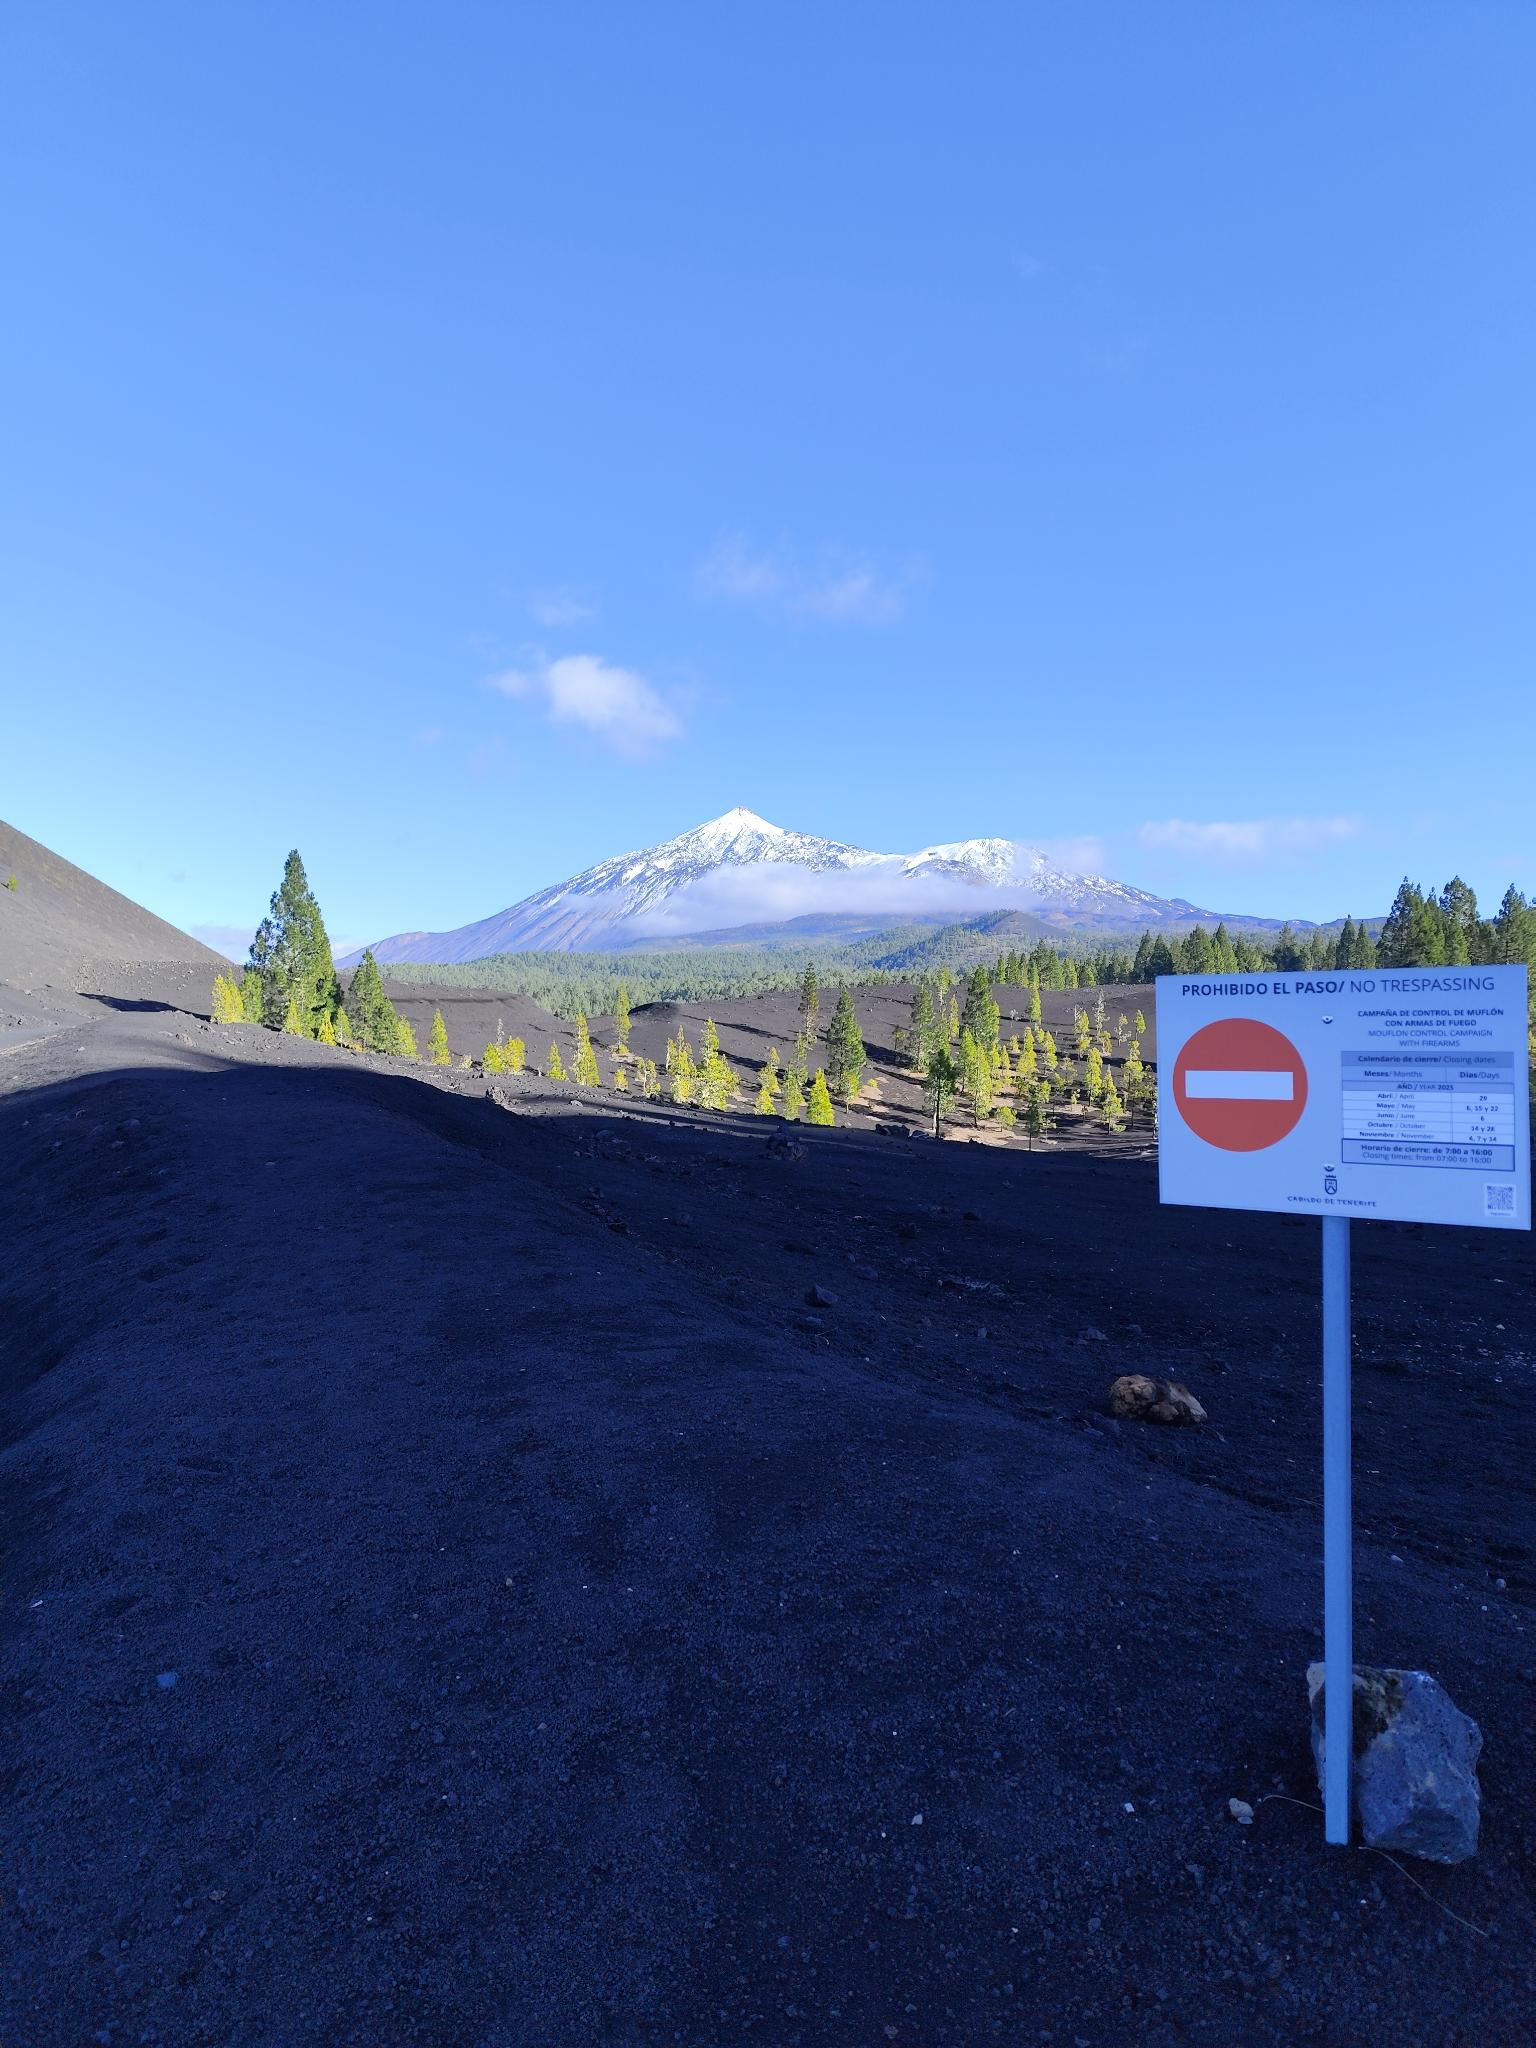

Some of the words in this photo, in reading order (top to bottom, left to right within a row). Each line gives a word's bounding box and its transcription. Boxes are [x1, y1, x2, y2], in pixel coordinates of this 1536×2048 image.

[1182, 982, 1268, 996] PROHIBIDO
[1273, 982, 1291, 995] EL
[1295, 980, 1345, 995] PASO/
[1350, 979, 1376, 994] NO
[1380, 976, 1495, 993] TRESPASSING
[1357, 1009, 1398, 1017] CAMPAÑA
[1412, 1009, 1452, 1017] CONTROL
[1467, 1008, 1504, 1016] MUFLÓN
[1385, 1019, 1402, 1027] CON
[1404, 1019, 1434, 1027] ARMAS
[1449, 1019, 1477, 1027] FUEGO
[1368, 1029, 1408, 1037] MOUFLON
[1409, 1029, 1449, 1037] CONTROL
[1450, 1029, 1493, 1037] CAMPAIGN
[1399, 1039, 1420, 1047] WITH
[1421, 1039, 1460, 1047] FIREARMS
[1357, 1055, 1401, 1063] Calendario
[1414, 1055, 1442, 1063] cierre/
[1443, 1056, 1473, 1065] Closing
[1474, 1056, 1496, 1064] dates
[1393, 1070, 1423, 1078] Months
[1445, 1147, 1462, 1155] 7:00
[1470, 1148, 1493, 1156] 16:00
[1362, 1152, 1390, 1161] Closing
[1415, 1154, 1435, 1162] from
[1469, 1156, 1492, 1164] 16:00
[1287, 1195, 1322, 1203] CABILDO
[1337, 1198, 1377, 1207] TENERIFE
